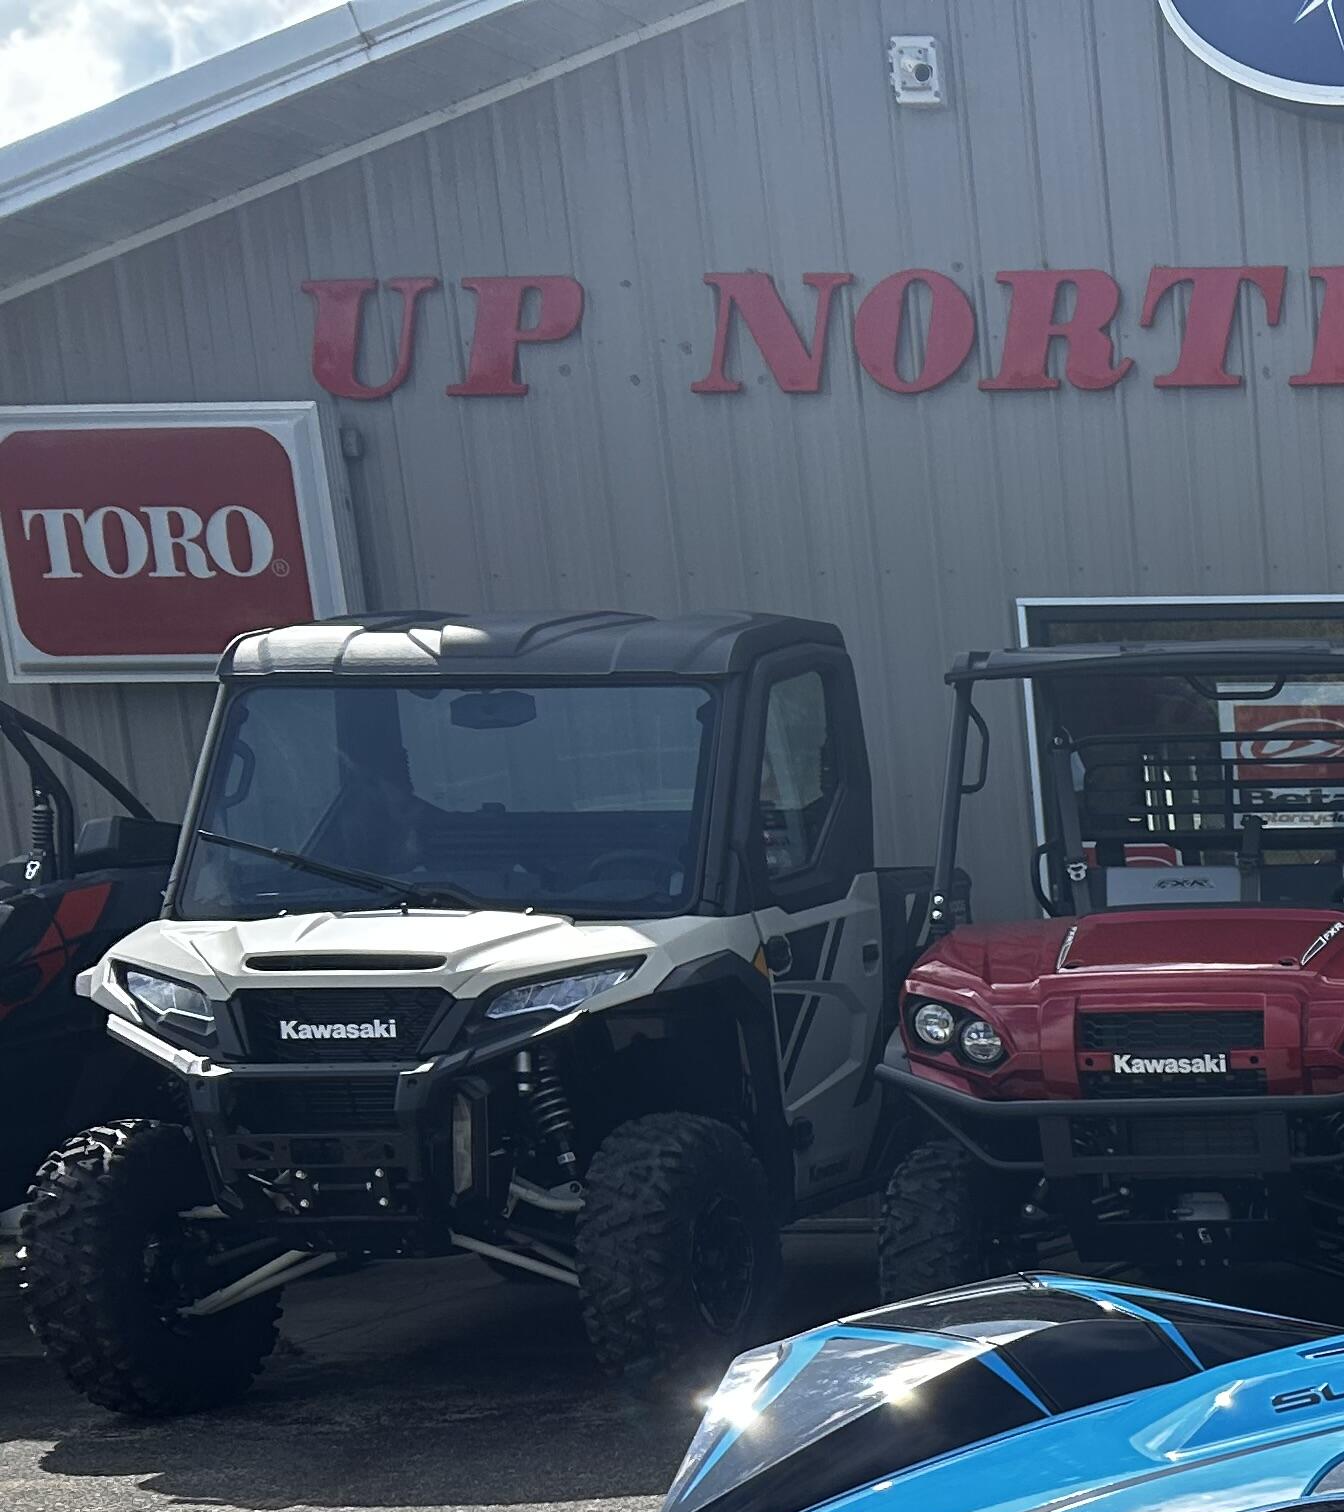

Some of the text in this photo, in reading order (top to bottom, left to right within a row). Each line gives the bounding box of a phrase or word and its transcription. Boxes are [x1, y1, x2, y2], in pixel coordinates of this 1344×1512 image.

[301, 275, 585, 400] UP
[279, 1018, 398, 1042] Kawasaki
[1113, 1053, 1228, 1075] Kawasaki
